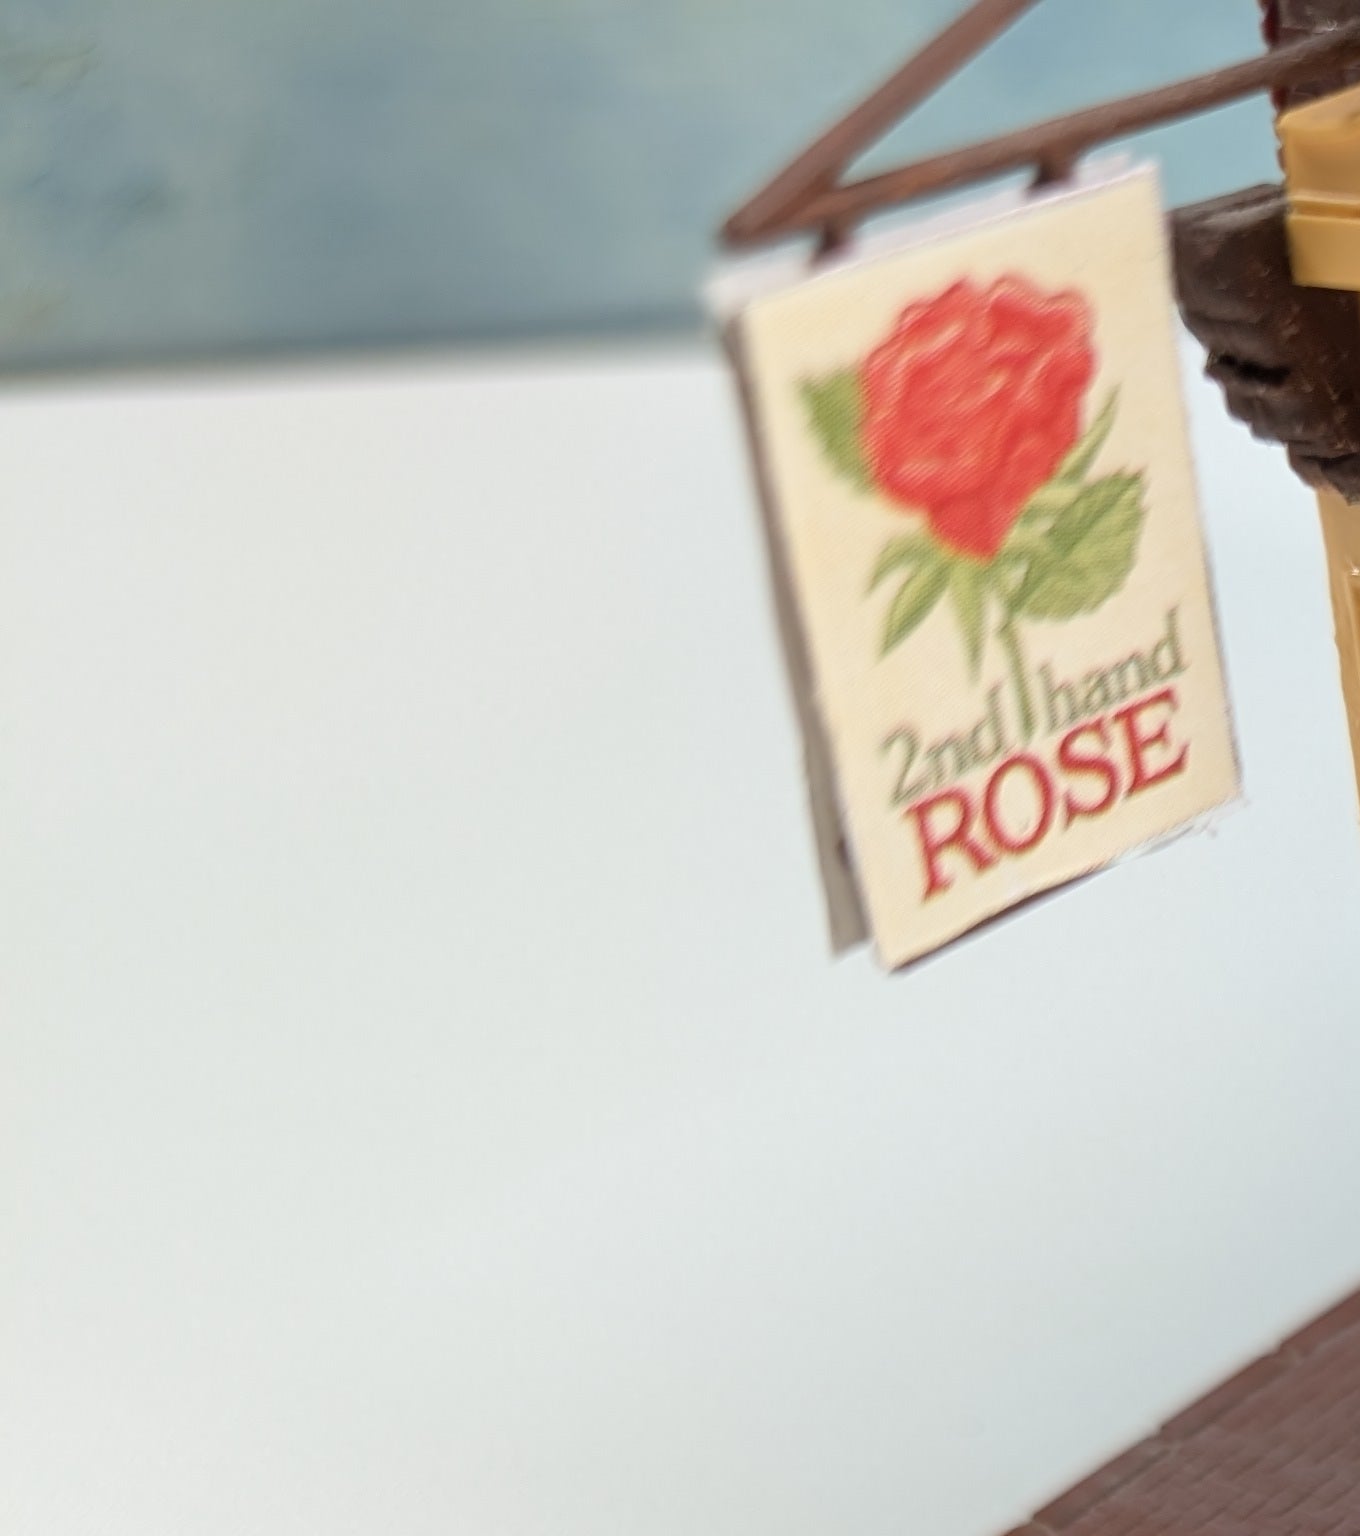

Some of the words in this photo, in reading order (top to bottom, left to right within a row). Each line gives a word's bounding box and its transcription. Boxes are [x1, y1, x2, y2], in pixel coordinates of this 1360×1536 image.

[879, 683, 1006, 802] 2nd
[1039, 606, 1187, 732] hand
[905, 686, 1189, 900] ROSE
